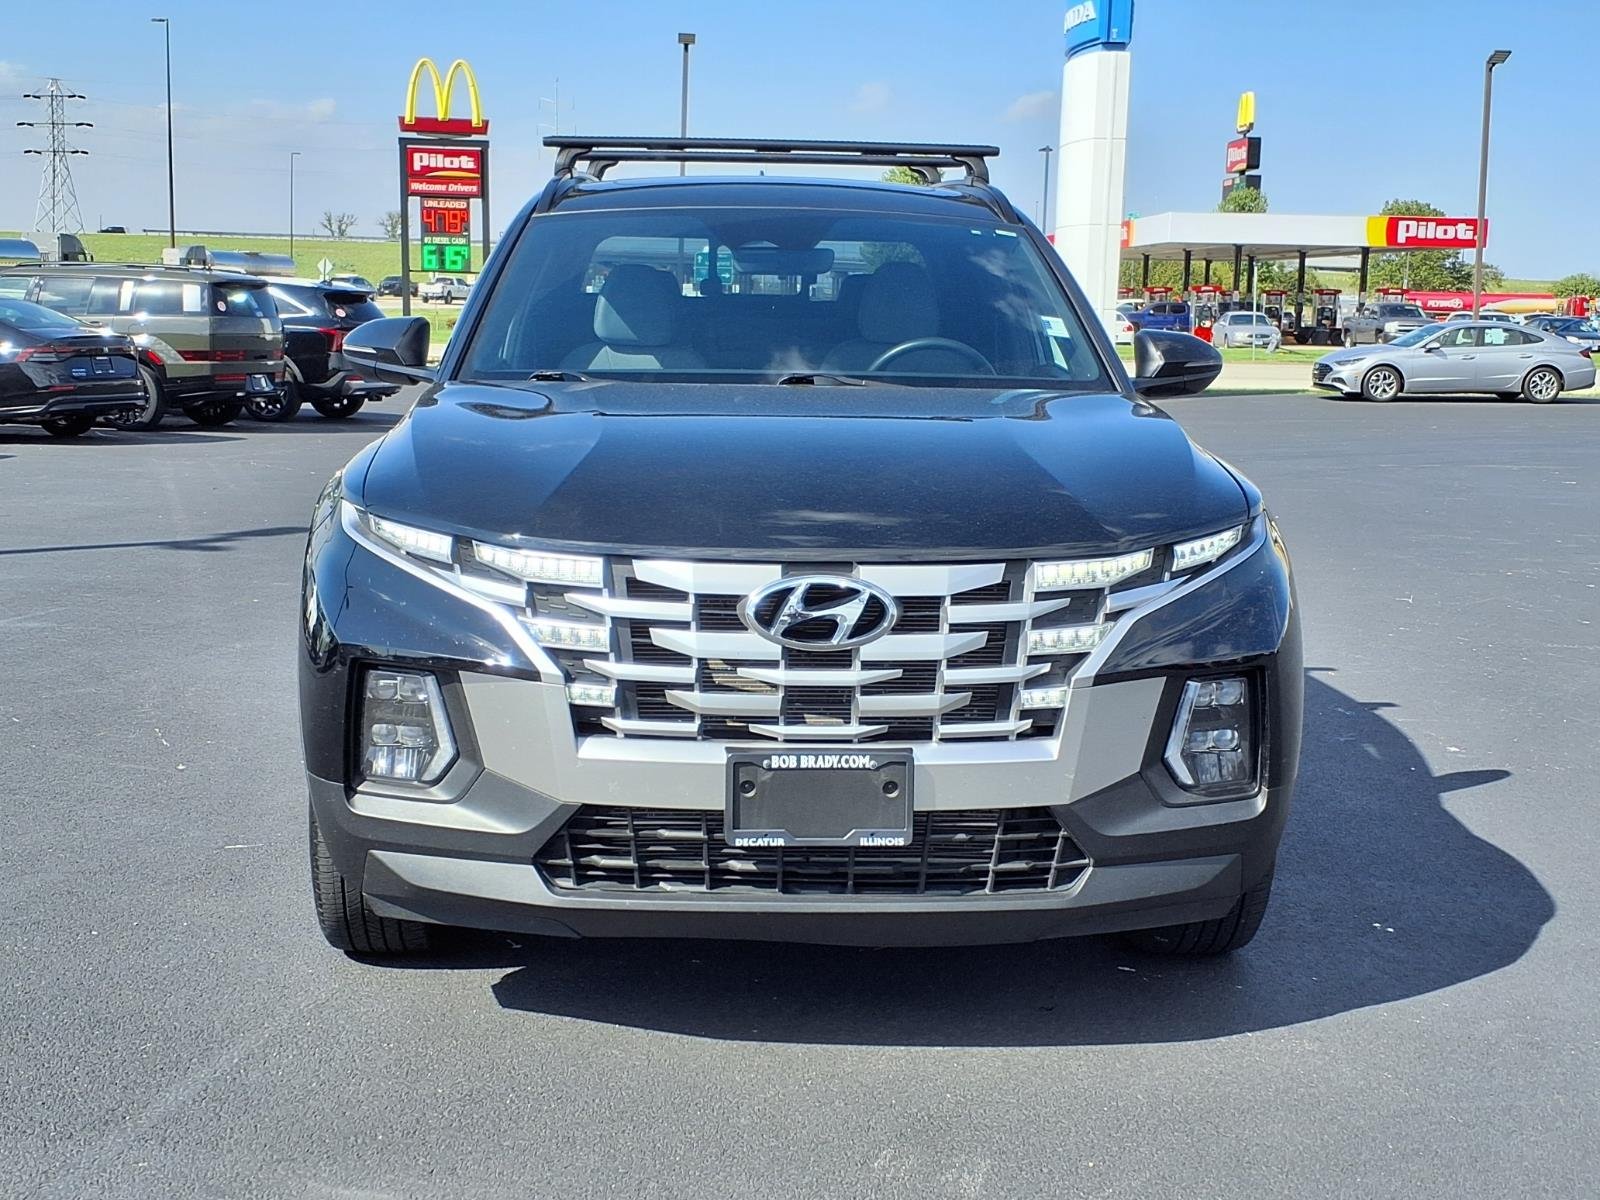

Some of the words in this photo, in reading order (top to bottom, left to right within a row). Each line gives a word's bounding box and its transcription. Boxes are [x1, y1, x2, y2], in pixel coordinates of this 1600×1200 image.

[413, 152, 477, 171] Pilot
[410, 182, 446, 192] Welcome
[448, 181, 478, 193] Drivers
[424, 200, 467, 208] UNLEADED
[1397, 220, 1474, 243] Pilot
[432, 236, 450, 244] DIESEL
[451, 236, 467, 244] CASH
[771, 755, 797, 769] BOB
[800, 755, 871, 769] BRADY.COM
[735, 837, 785, 847] DECATUR
[859, 837, 904, 846] ILLINOIS
